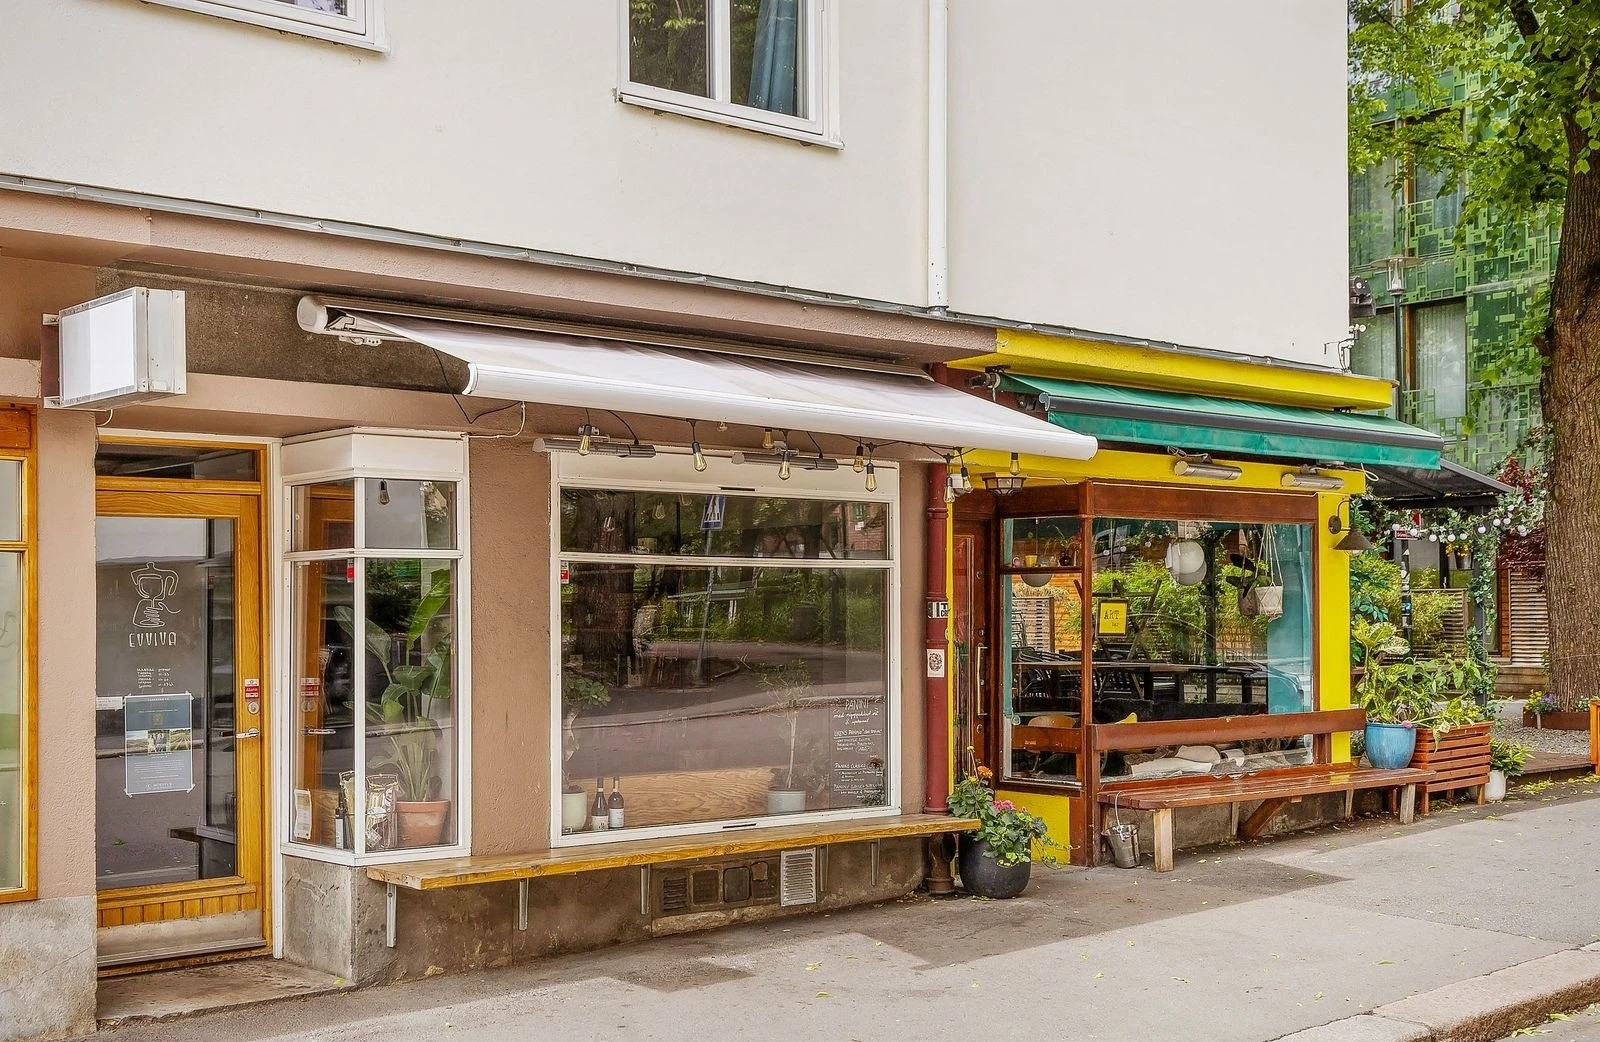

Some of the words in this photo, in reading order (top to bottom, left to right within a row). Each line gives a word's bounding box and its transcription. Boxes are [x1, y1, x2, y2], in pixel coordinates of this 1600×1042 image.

[1103, 609, 1120, 620] ART
[128, 631, 177, 648] EVVIVA
[844, 698, 869, 710] PANINI
